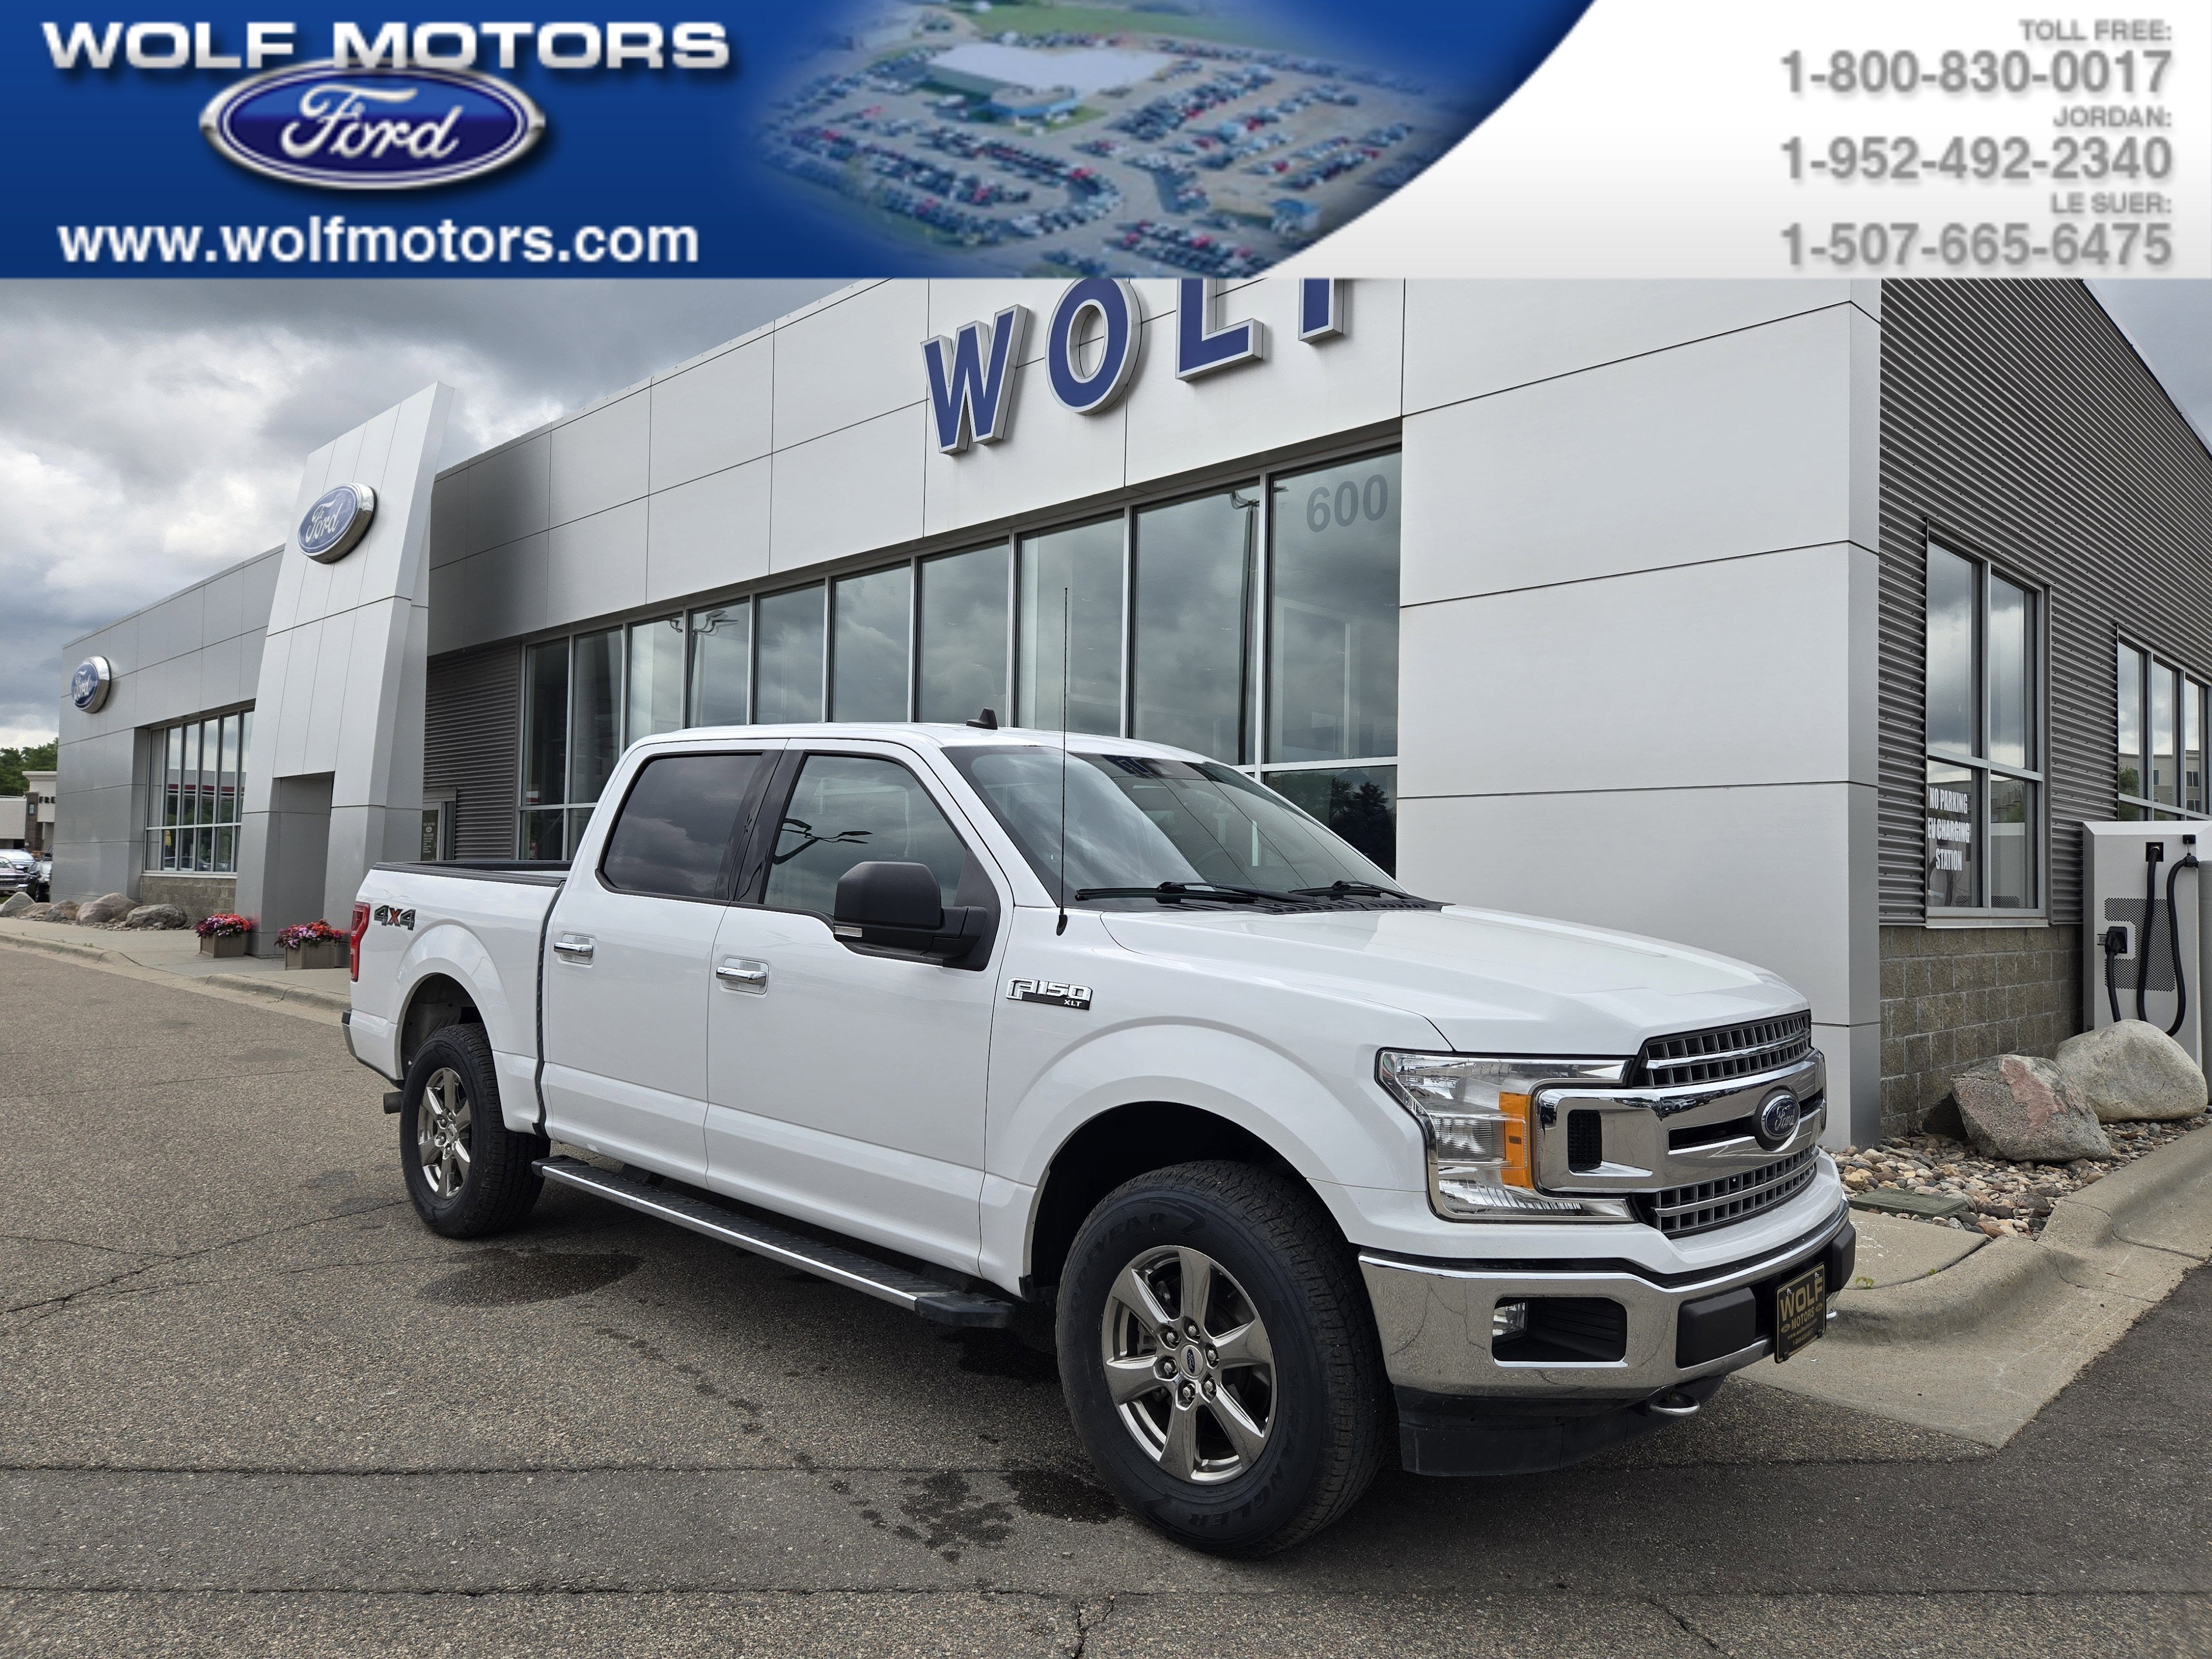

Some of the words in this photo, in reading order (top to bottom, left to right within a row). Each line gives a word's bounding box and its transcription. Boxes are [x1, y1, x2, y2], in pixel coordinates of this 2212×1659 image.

[1306, 474, 1389, 533] 600
[305, 499, 344, 543] Ford
[74, 669, 91, 701] Ford
[1929, 787, 1939, 810] NO
[1940, 789, 1968, 815] PARKING
[1927, 817, 1936, 839] EV
[1937, 818, 1970, 843] CHARGING
[1936, 848, 1962, 872] STATION
[1774, 1104, 1795, 1131] Ford
[1780, 1276, 1823, 1322] WOLF
[1791, 1306, 1815, 1331] MOTORS
